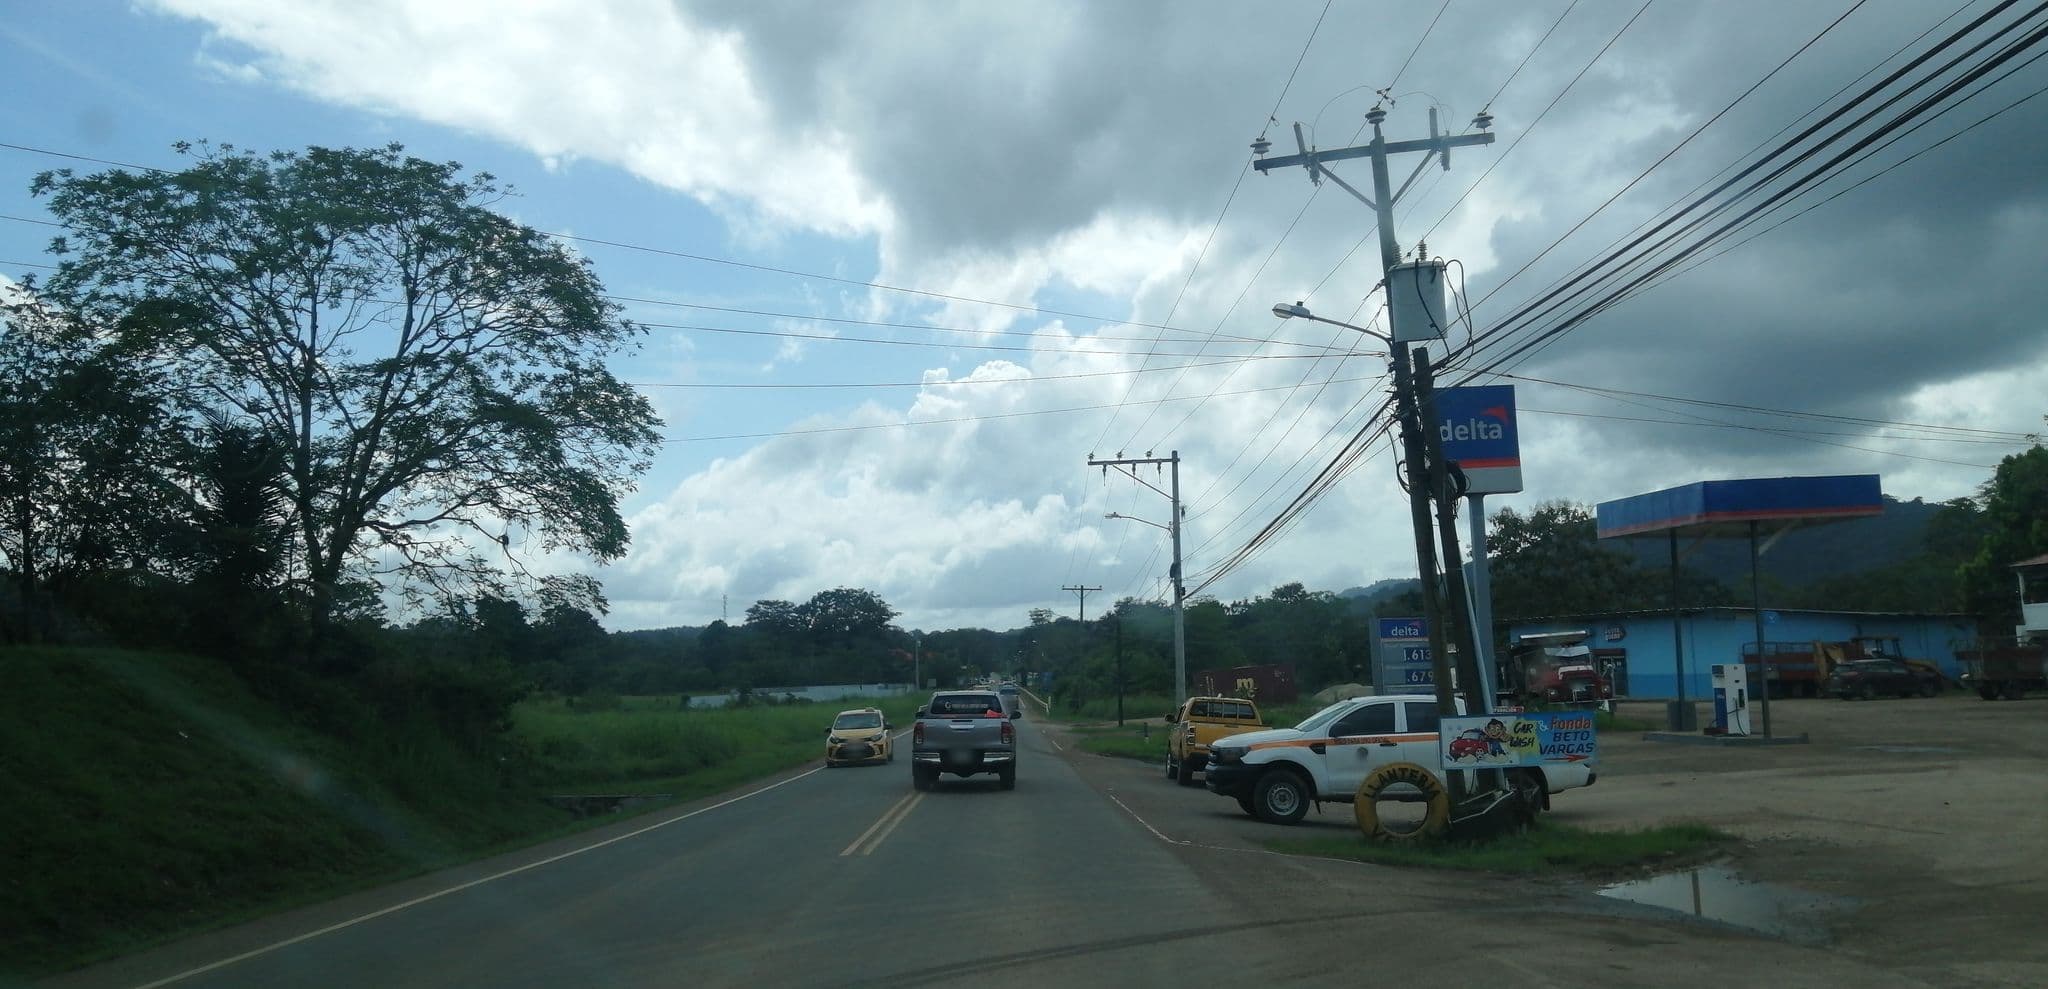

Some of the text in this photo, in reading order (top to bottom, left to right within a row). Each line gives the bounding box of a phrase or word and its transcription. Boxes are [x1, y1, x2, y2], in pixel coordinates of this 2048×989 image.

[1440, 418, 1502, 442] delta
[1391, 625, 1419, 636] delta
[1513, 721, 1534, 733] CAR
[1553, 730, 1590, 742] BETO
[1509, 737, 1535, 748] WASH
[1539, 742, 1595, 755] VARGAS
